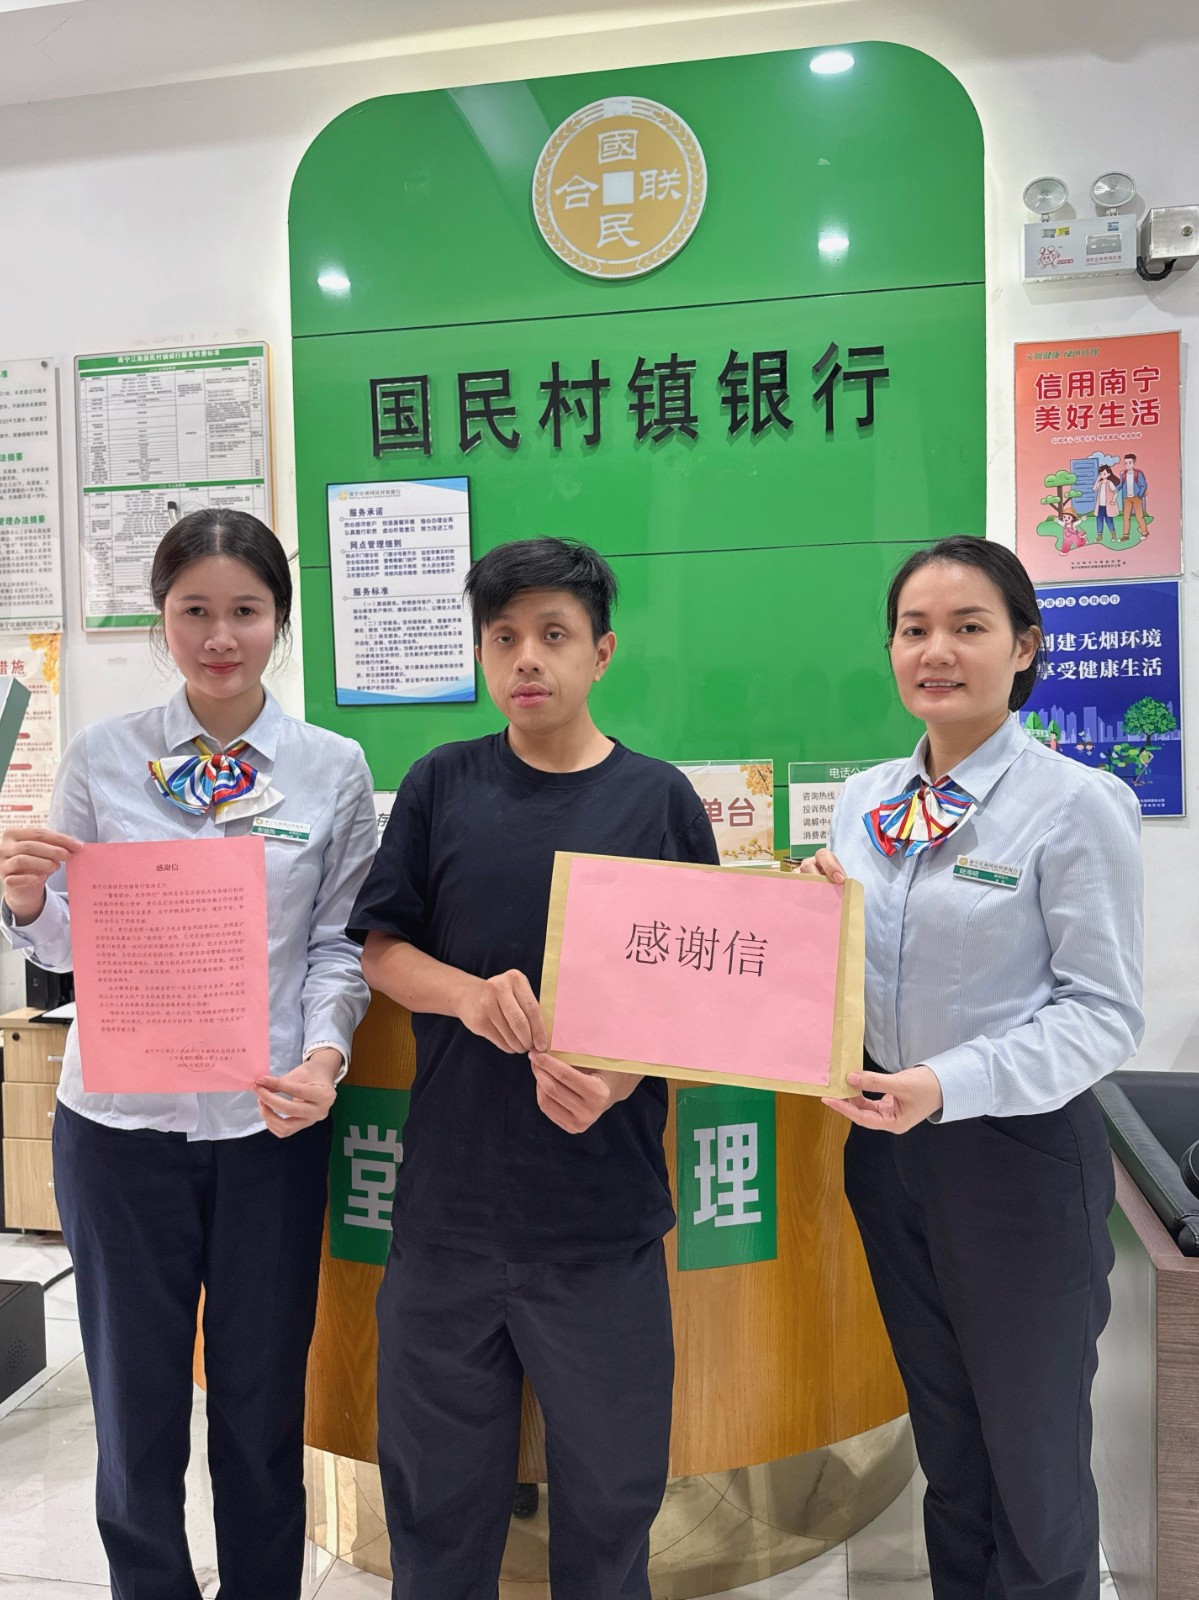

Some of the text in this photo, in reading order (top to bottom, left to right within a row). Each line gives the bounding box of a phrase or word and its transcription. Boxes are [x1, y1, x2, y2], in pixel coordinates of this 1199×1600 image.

[597, 129, 639, 165] 國
[555, 168, 682, 211] 合 联
[596, 212, 641, 248] 民
[1034, 365, 1160, 400] 信用南宁
[369, 341, 890, 457] 国民村镇银行
[1034, 397, 1160, 432] 美好生活
[349, 507, 383, 517] 服务承诺
[350, 539, 402, 550] 网点管理细则
[353, 587, 389, 597] 服务标准
[1079, 595, 1120, 606] 你我同行
[702, 797, 756, 827] 单台
[803, 804, 834, 814] 投诉热线
[803, 830, 830, 840] 消费者
[156, 863, 179, 872] 感谢信
[625, 920, 768, 977] 感谢信
[343, 1122, 762, 1231] 堂 理
